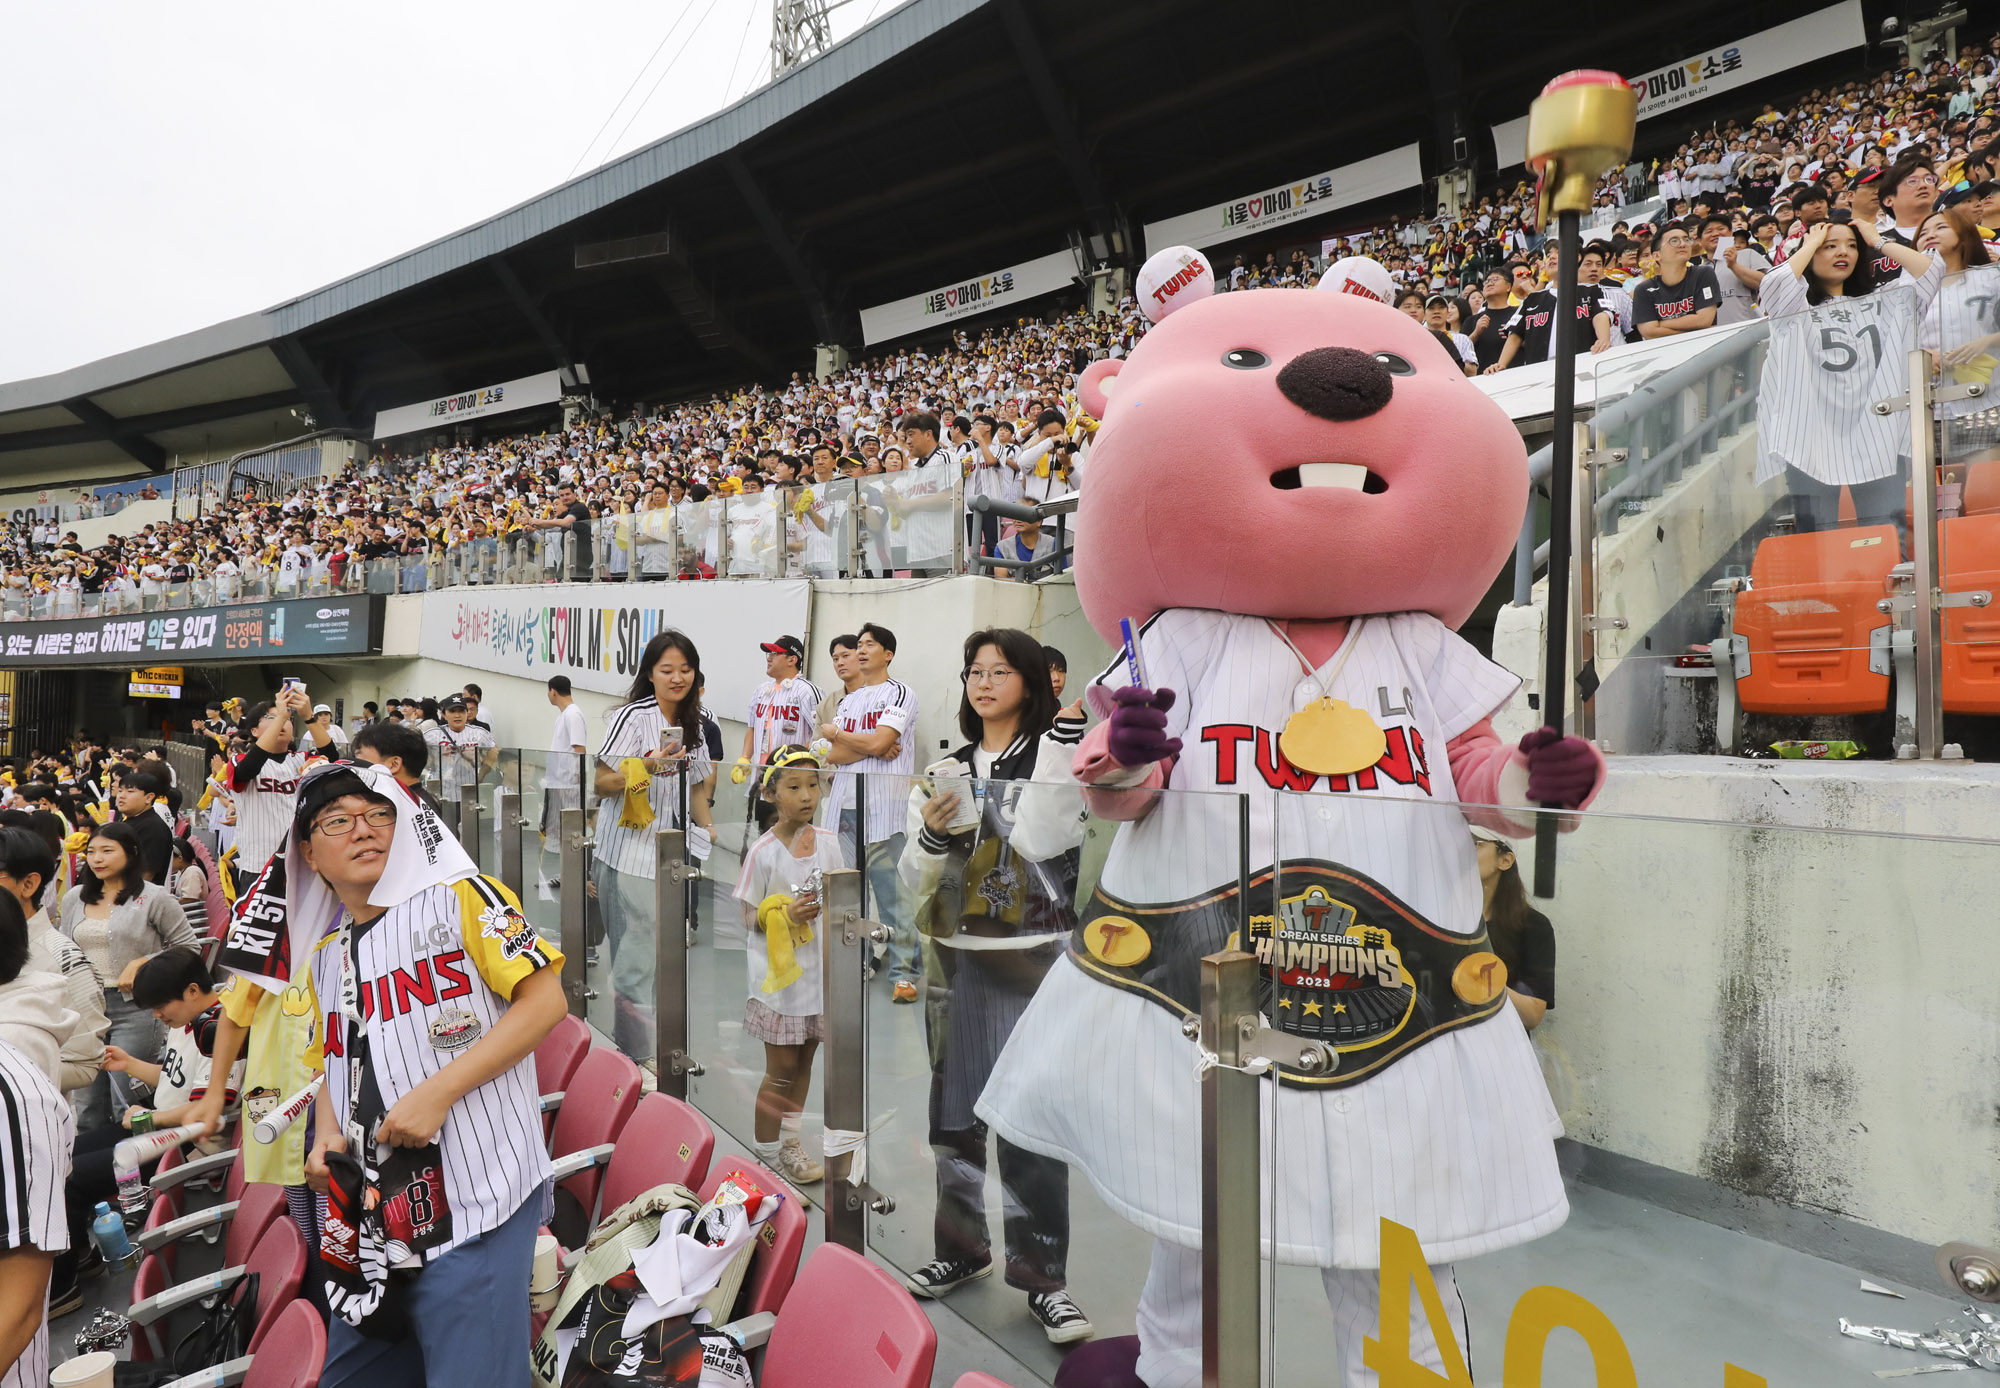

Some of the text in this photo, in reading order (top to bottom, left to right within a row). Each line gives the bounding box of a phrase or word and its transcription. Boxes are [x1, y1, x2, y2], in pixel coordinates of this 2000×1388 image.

[1668, 93, 1687, 104] 서울이
[1689, 85, 1708, 97] 됩니다
[1869, 256, 1900, 277] TW
[1153, 259, 1205, 305] TWINS
[1342, 278, 1384, 303] TWI
[1654, 296, 1694, 318] TWINS
[1820, 324, 1882, 372] 51
[286, 561, 292, 572] 8
[6, 634, 33, 656] 있는
[33, 633, 73, 655] 사람은
[73, 631, 98, 654] 없다
[100, 620, 146, 653] 하지만
[146, 617, 180, 651] 약은
[180, 614, 218, 650] 있다
[225, 620, 263, 649] 안정액
[491, 607, 514, 657] 특별시
[515, 607, 540, 667] 서울
[154, 673, 179, 682] CHICKEN
[1201, 724, 1433, 797] TWNS
[631, 780, 650, 792] WINS
[415, 813, 428, 839] 하나의
[255, 893, 287, 923] 51
[413, 923, 451, 952] LG
[1280, 930, 1360, 945] OREAN SERIES
[1250, 936, 1402, 989] HAMPIONS
[1296, 975, 1331, 988] 2023
[283, 1092, 313, 1122] TWINS
[151, 1130, 180, 1148] TWINS
[679, 1145, 690, 1159] 247
[406, 1180, 434, 1226] 8
[704, 1355, 734, 1373] 하나의
